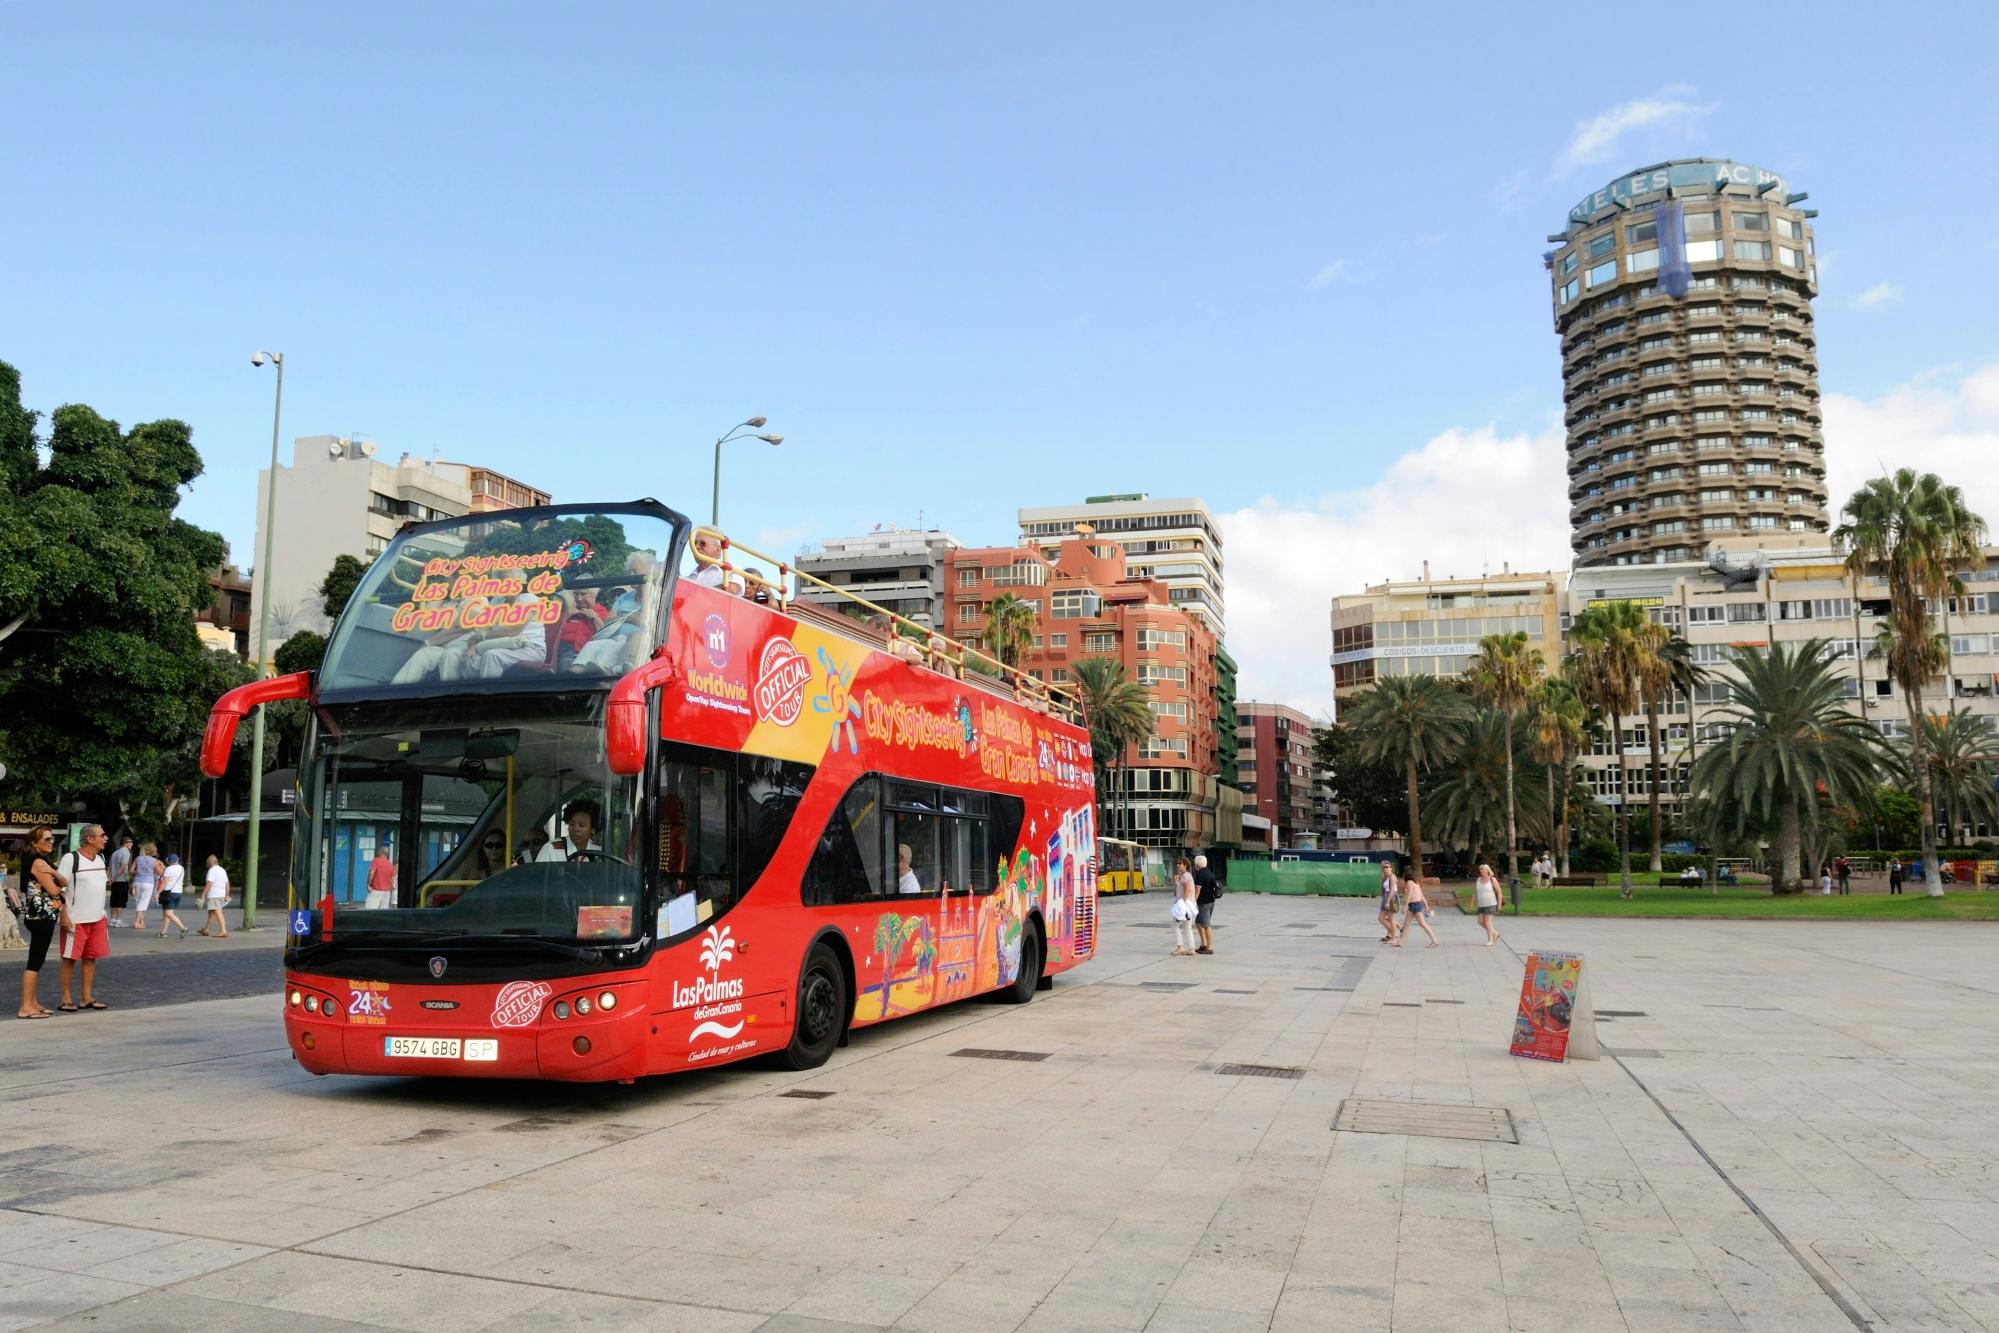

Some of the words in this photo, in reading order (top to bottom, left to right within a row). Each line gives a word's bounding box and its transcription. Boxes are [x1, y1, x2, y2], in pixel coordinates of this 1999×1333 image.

[1717, 166, 1749, 183] AC
[424, 558, 462, 577] City
[462, 552, 570, 575] Sightseeing
[412, 579, 448, 602] Las
[450, 575, 522, 599] Palmas
[527, 571, 562, 594] de
[392, 602, 454, 631] Gran
[460, 597, 562, 629] Canaria
[761, 658, 810, 710] OFFICIAL
[780, 690, 801, 718] TOUR
[864, 689, 894, 746] City
[893, 700, 966, 759] Sightseeing
[981, 700, 996, 737] Las
[995, 705, 1023, 745] Palmas
[1022, 719, 1033, 748] de
[980, 735, 1006, 780] Gran
[1005, 746, 1038, 784] Canaria
[11, 812, 58, 824] ENSALADES
[349, 990, 371, 1014] 24
[497, 985, 549, 1024] OFFICIAL
[516, 1004, 539, 1024] TOUR
[394, 1040, 427, 1055] 9574
[431, 1041, 458, 1056] GBG
[468, 1042, 493, 1058] SP
[688, 1048, 710, 1062] Ciudad
[709, 1046, 717, 1057] de
[717, 1046, 730, 1055] mar
[735, 1039, 757, 1051] culturas
